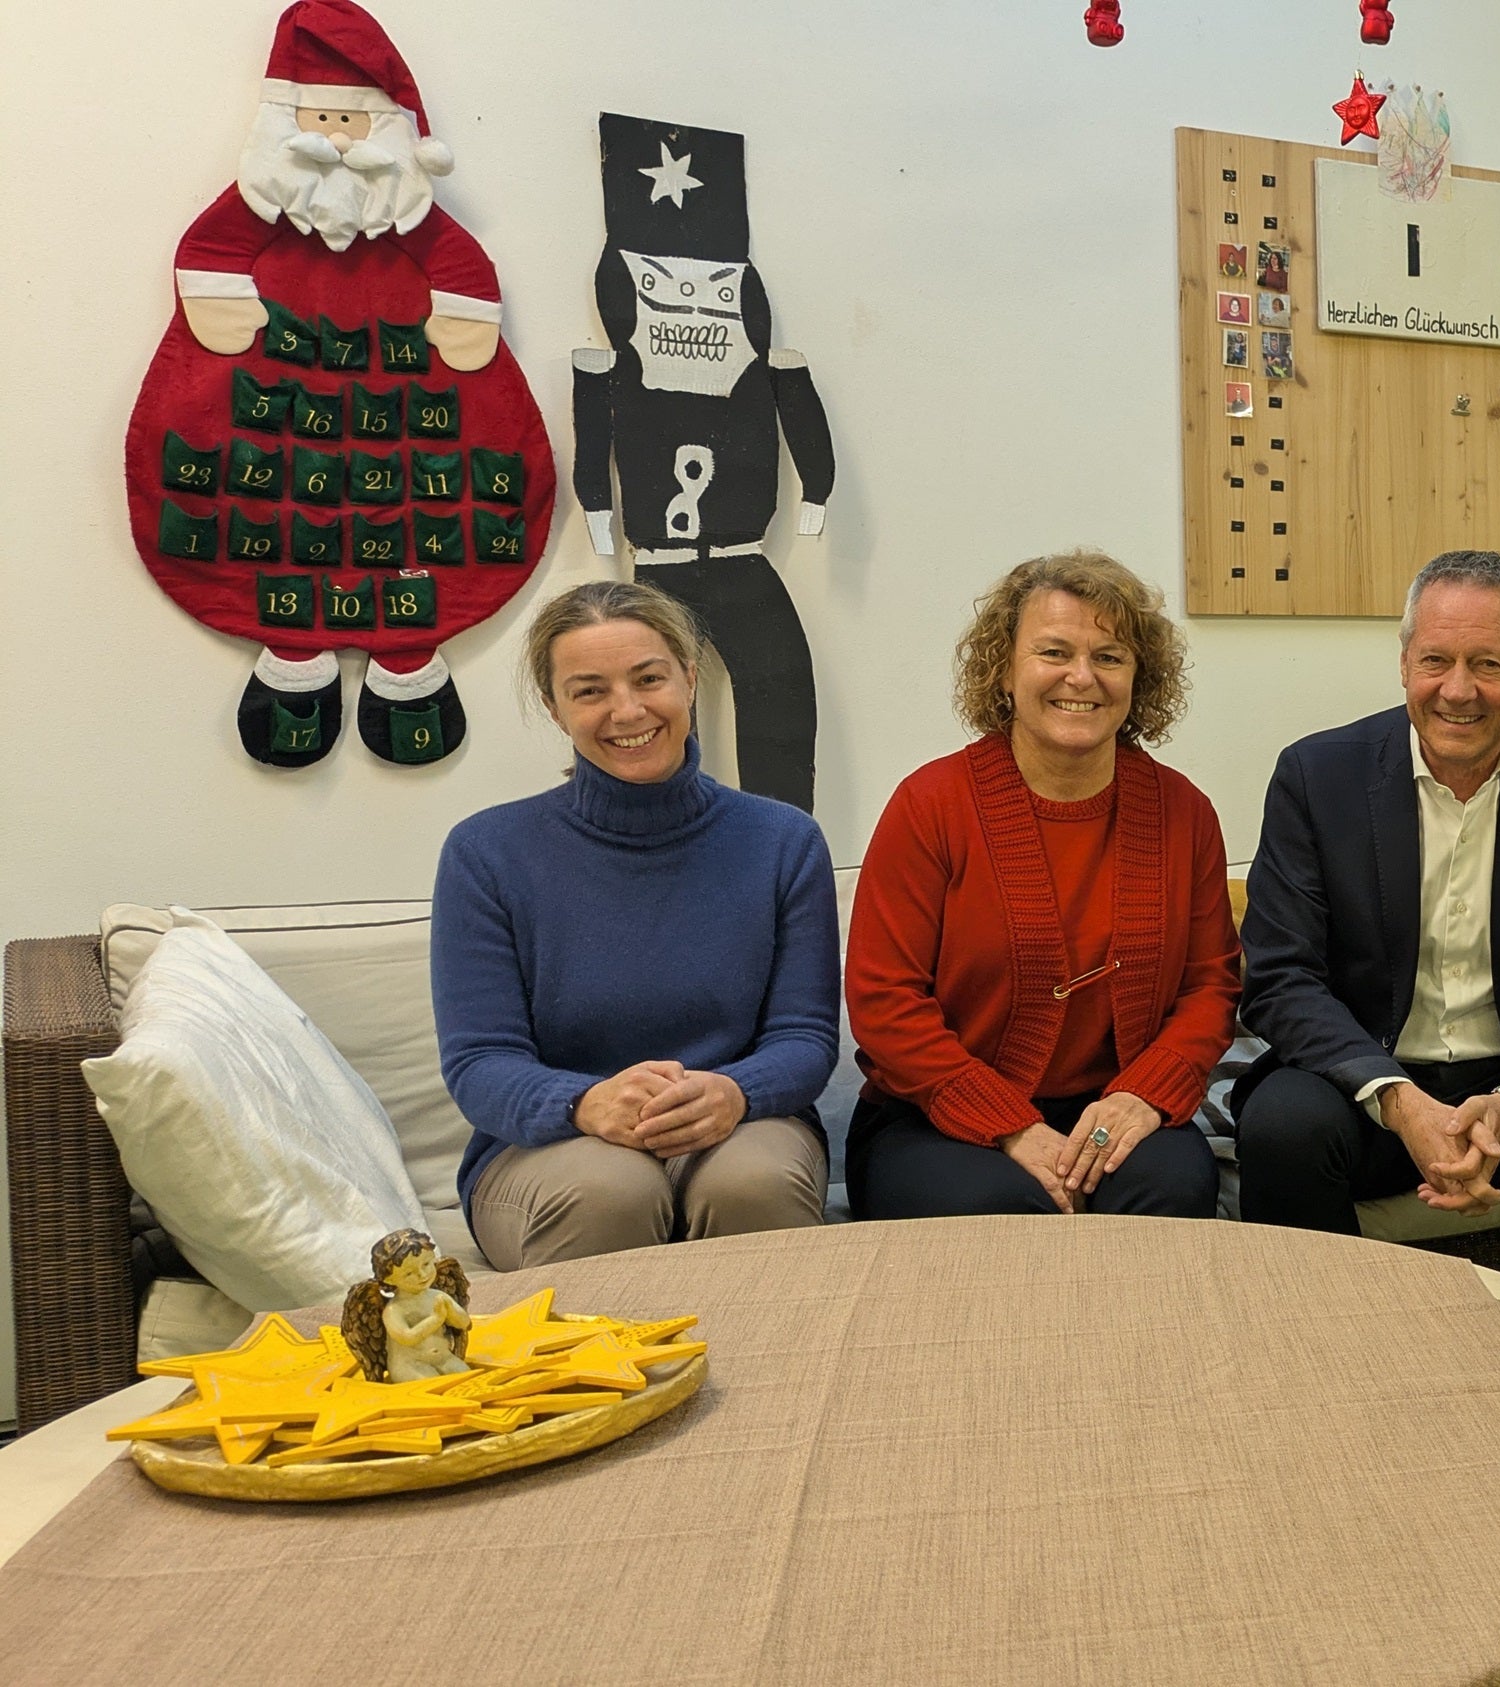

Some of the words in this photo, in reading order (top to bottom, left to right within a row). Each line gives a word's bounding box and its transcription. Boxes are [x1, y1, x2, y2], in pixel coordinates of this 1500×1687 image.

[1327, 300, 1398, 328] Herzlichen
[1404, 306, 1500, 339] Glückwunsch
[281, 331, 297, 351] 3
[335, 342, 352, 364] 7
[390, 344, 416, 363] 14
[253, 396, 270, 417] 5
[305, 410, 332, 432] 16
[363, 411, 386, 431] 15
[422, 407, 447, 428] 20
[179, 465, 211, 484] 23
[241, 465, 272, 487] 12
[309, 473, 326, 492] 6
[365, 471, 392, 489] 21
[425, 474, 450, 495] 11
[493, 473, 509, 493] 8
[185, 533, 198, 553] 1
[243, 538, 270, 557] 19
[308, 542, 326, 562] 2
[363, 541, 392, 559] 22
[426, 535, 441, 553] 4
[492, 537, 518, 554] 24
[267, 593, 297, 614] 13
[331, 594, 359, 617] 10
[390, 593, 417, 615] 18
[290, 728, 316, 748] 17
[415, 729, 429, 748] 9
